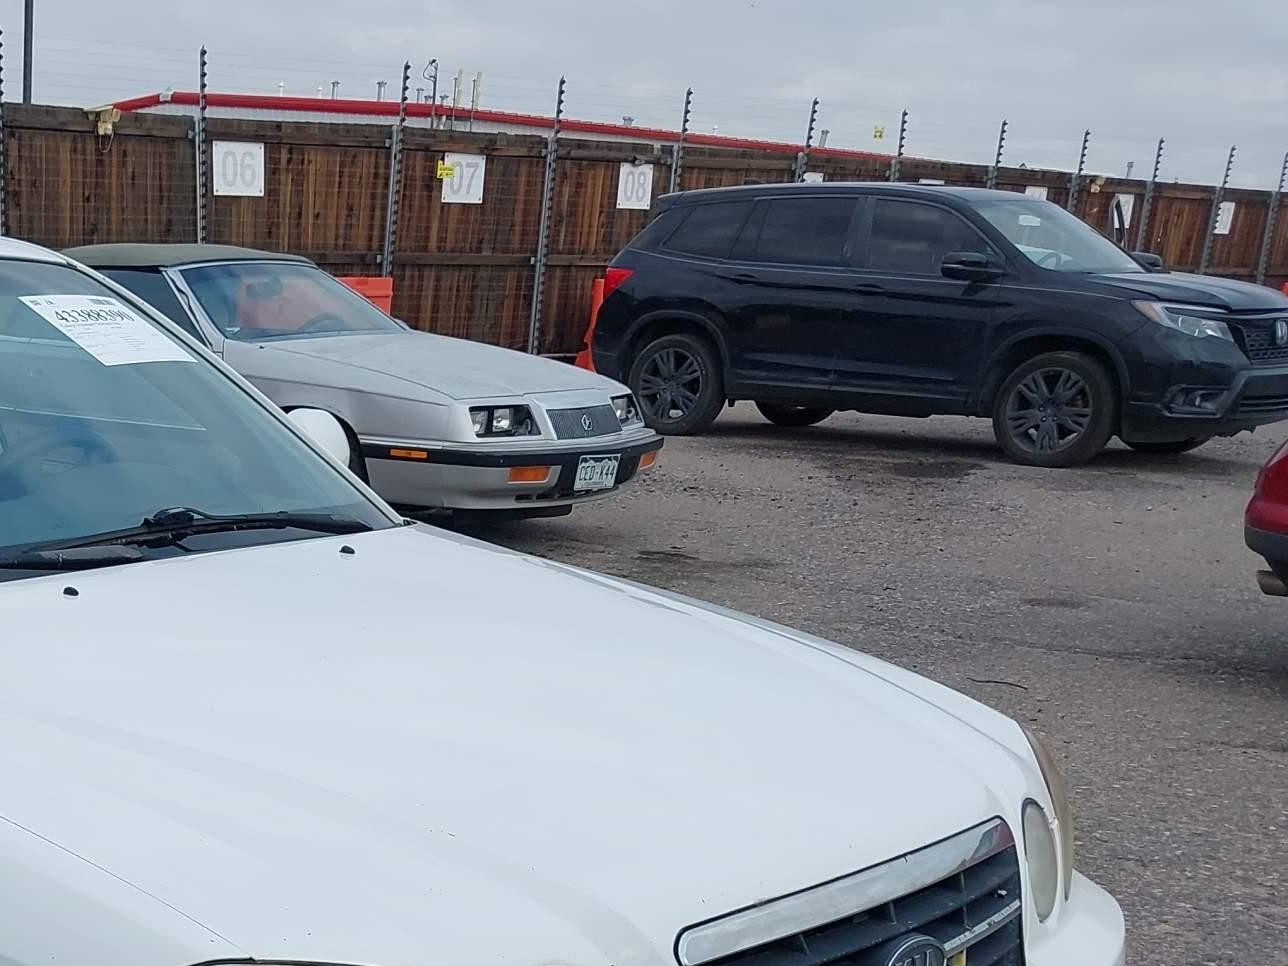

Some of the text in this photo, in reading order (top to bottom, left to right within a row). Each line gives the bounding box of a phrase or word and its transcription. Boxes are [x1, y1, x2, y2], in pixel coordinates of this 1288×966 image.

[222, 150, 257, 188] 06
[450, 160, 480, 195] 07
[624, 170, 647, 202] 08
[54, 308, 136, 323] 43388390
